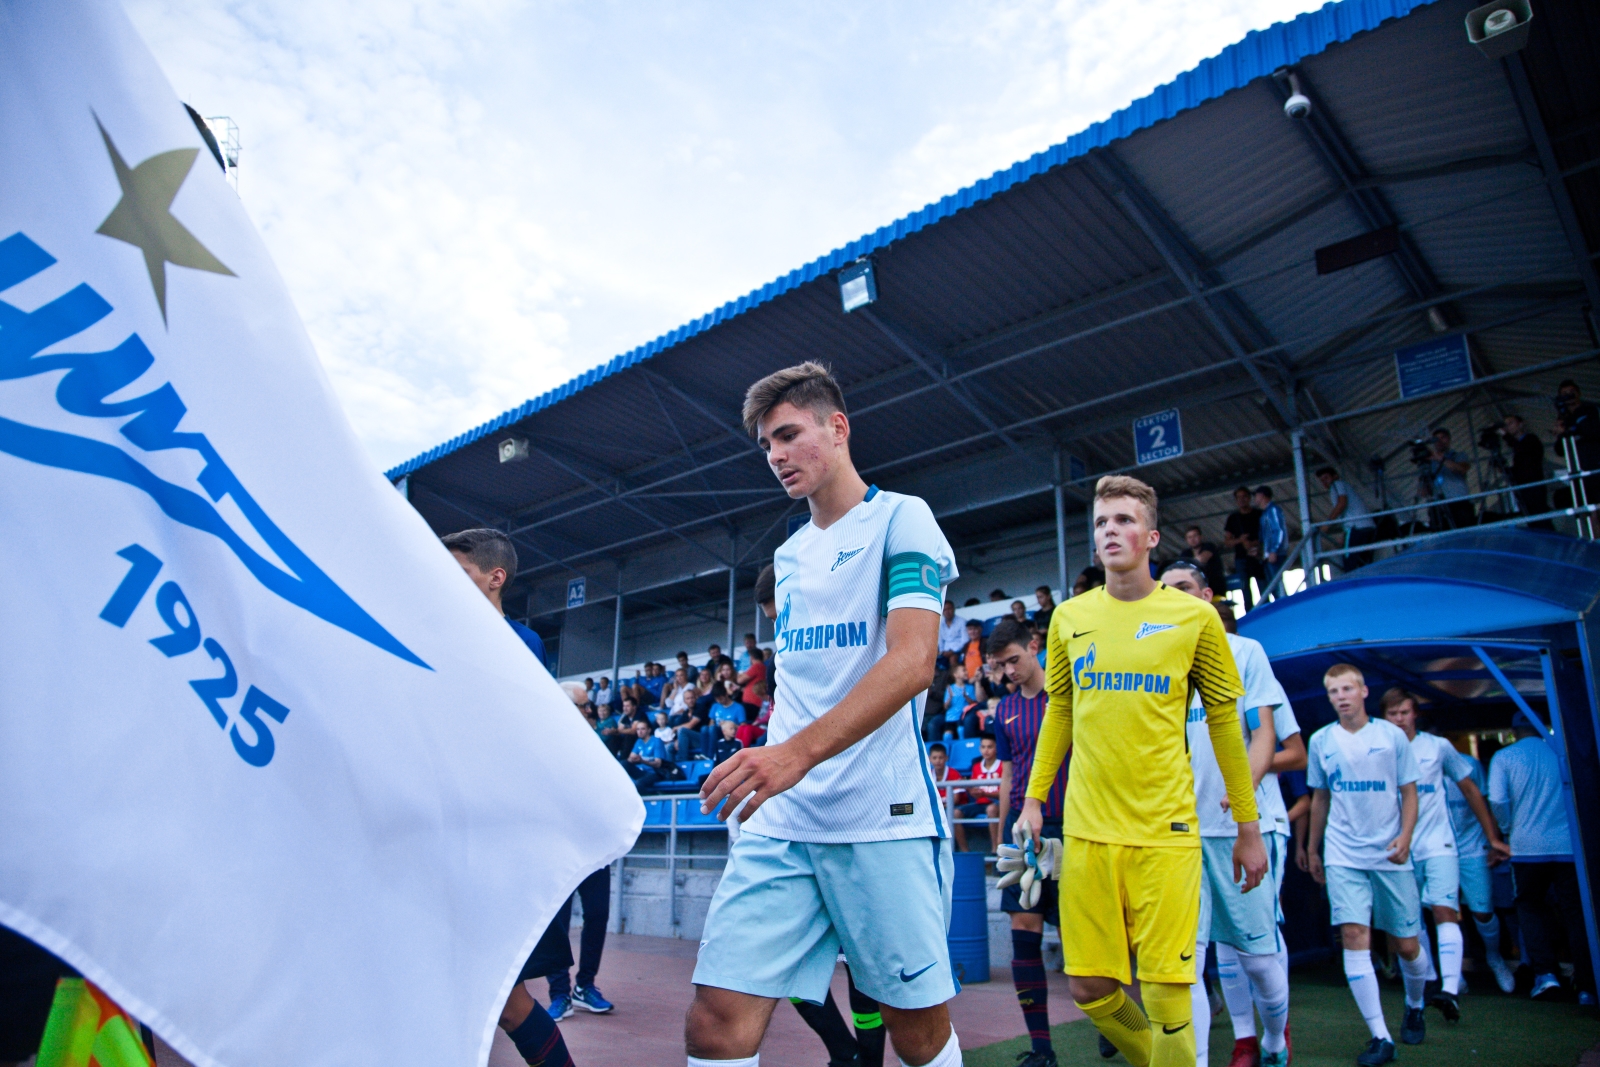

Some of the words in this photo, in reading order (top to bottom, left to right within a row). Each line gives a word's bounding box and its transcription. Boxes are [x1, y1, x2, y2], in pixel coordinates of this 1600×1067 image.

[1136, 411, 1176, 428] СЕКТОР
[1149, 425, 1167, 449] 2
[1140, 445, 1179, 462] SECTOR
[788, 621, 868, 653] ГАЗПРОМ
[99, 543, 290, 767] 1925
[1097, 672, 1171, 695] ГАЗПРОМ
